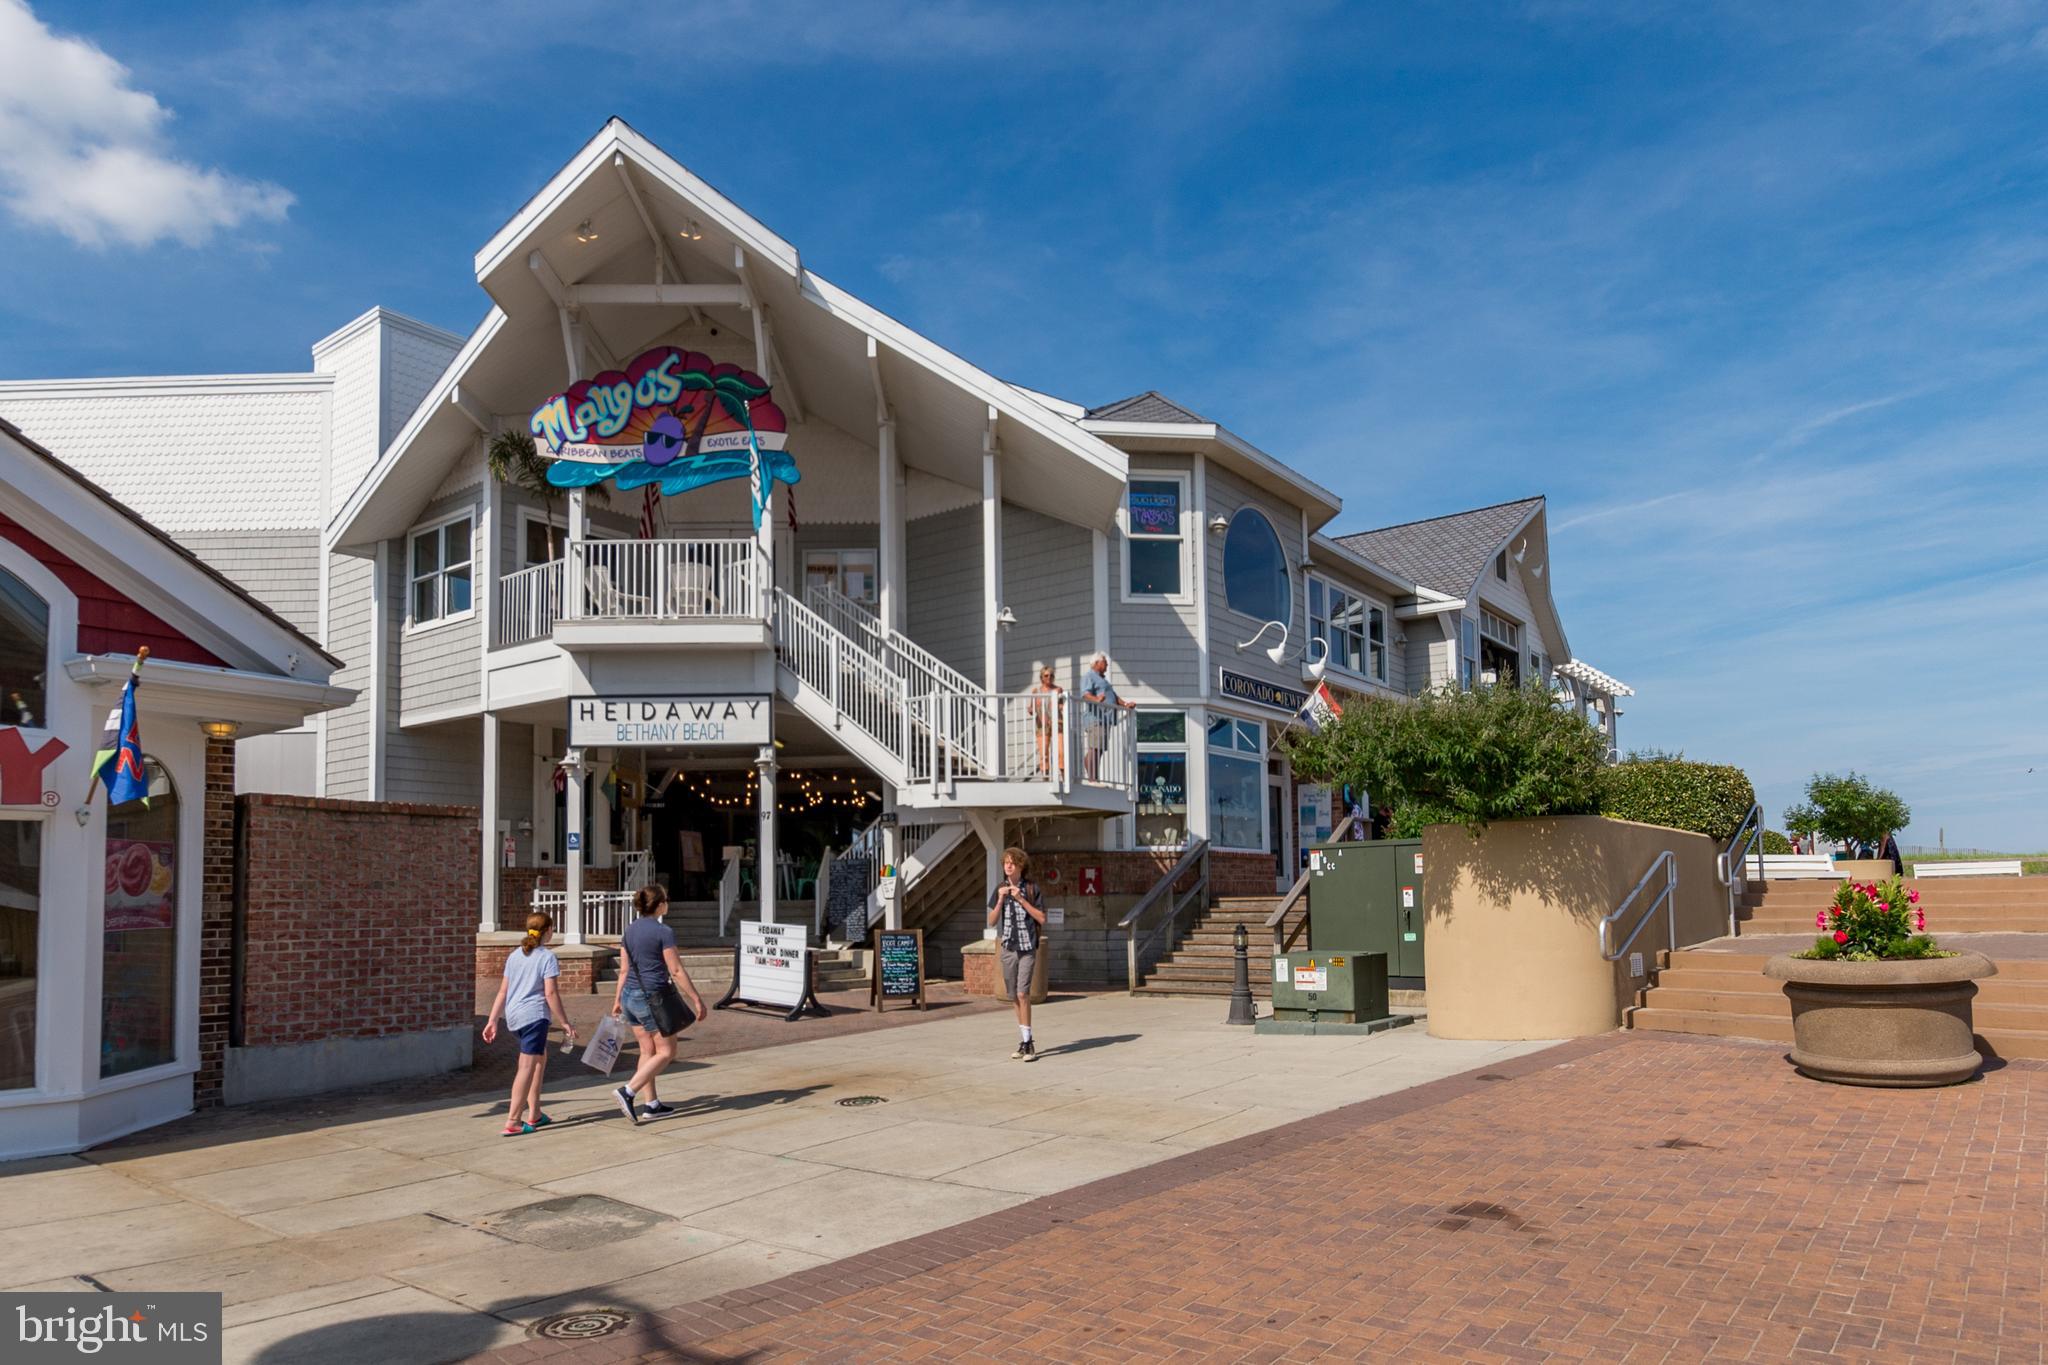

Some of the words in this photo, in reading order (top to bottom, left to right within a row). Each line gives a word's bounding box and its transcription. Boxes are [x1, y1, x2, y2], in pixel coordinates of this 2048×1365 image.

[707, 435, 740, 448] EXOTIC
[742, 435, 766, 447] ES
[546, 445, 607, 458] CRIBBEAN
[610, 447, 643, 459] BEATS
[1223, 675, 1275, 703] CORONADO
[1280, 690, 1306, 709] JEWE
[580, 700, 760, 721] HEIDAWAY
[616, 723, 679, 741] BETHANY
[683, 722, 725, 741] BEACH
[1139, 784, 1182, 793] CONADO
[761, 810, 771, 821] 97
[764, 936, 778, 945] OPEN
[746, 945, 764, 955] LUNCH
[766, 947, 777, 956] AND
[780, 949, 799, 958] DINNER
[1307, 992, 1317, 1001] 50
